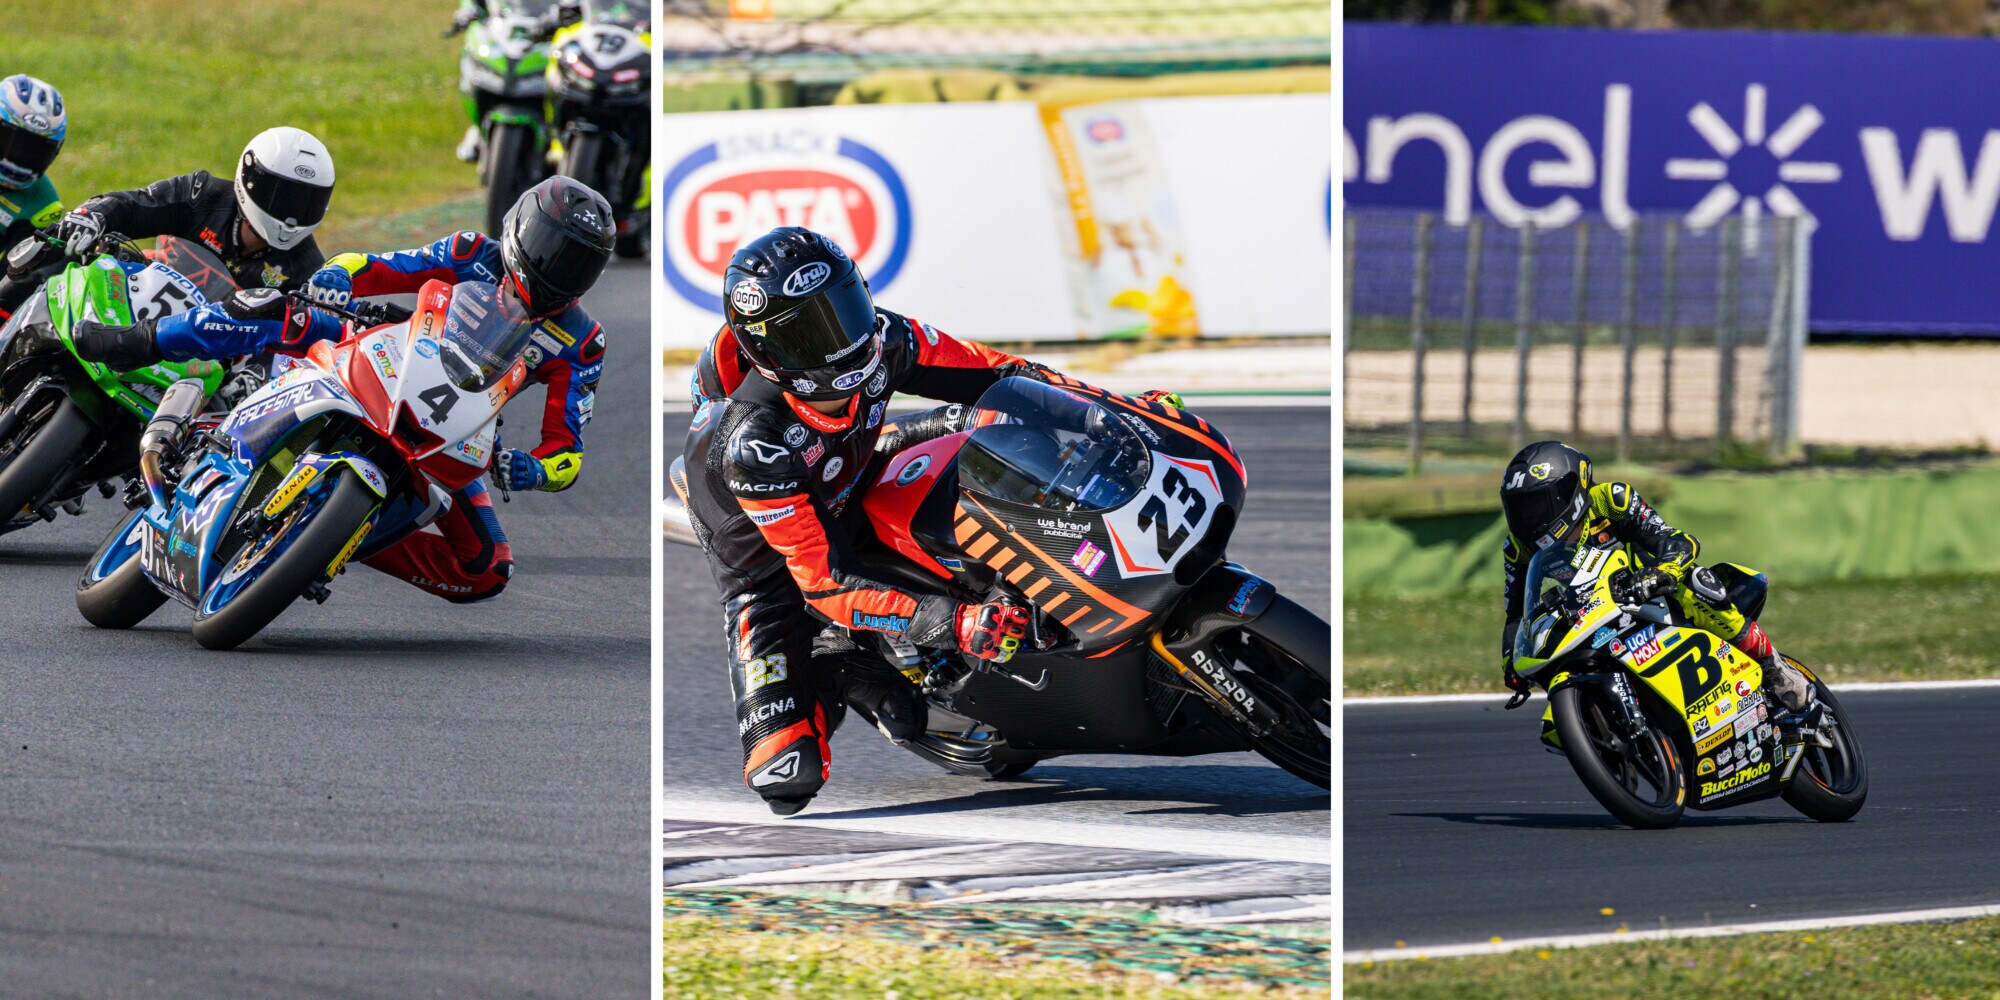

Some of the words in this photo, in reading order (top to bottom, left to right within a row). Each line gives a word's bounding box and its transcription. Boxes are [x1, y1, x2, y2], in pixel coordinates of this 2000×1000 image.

[790, 261, 829, 291] Arai
[203, 321, 259, 333] REV'IT!
[372, 343, 398, 379] Gemar
[417, 383, 460, 425] 4
[797, 404, 848, 431] MACNA
[456, 440, 484, 459] Gemar
[267, 466, 313, 512] DUNLOP
[729, 479, 799, 493] MACNA
[1037, 518, 1055, 527] we
[1057, 518, 1092, 532] brand
[1137, 465, 1207, 564] 23
[853, 611, 909, 633] Lucky
[1633, 637, 1661, 667] MOLY
[1639, 632, 1723, 707] B
[745, 652, 787, 693] 23
[1190, 649, 1255, 713] DUNLOP
[739, 696, 796, 736] MACNA
[1686, 680, 1732, 719] RACING
[1704, 727, 1732, 749] DUNLOP
[1700, 761, 1772, 797] BucciMoto
